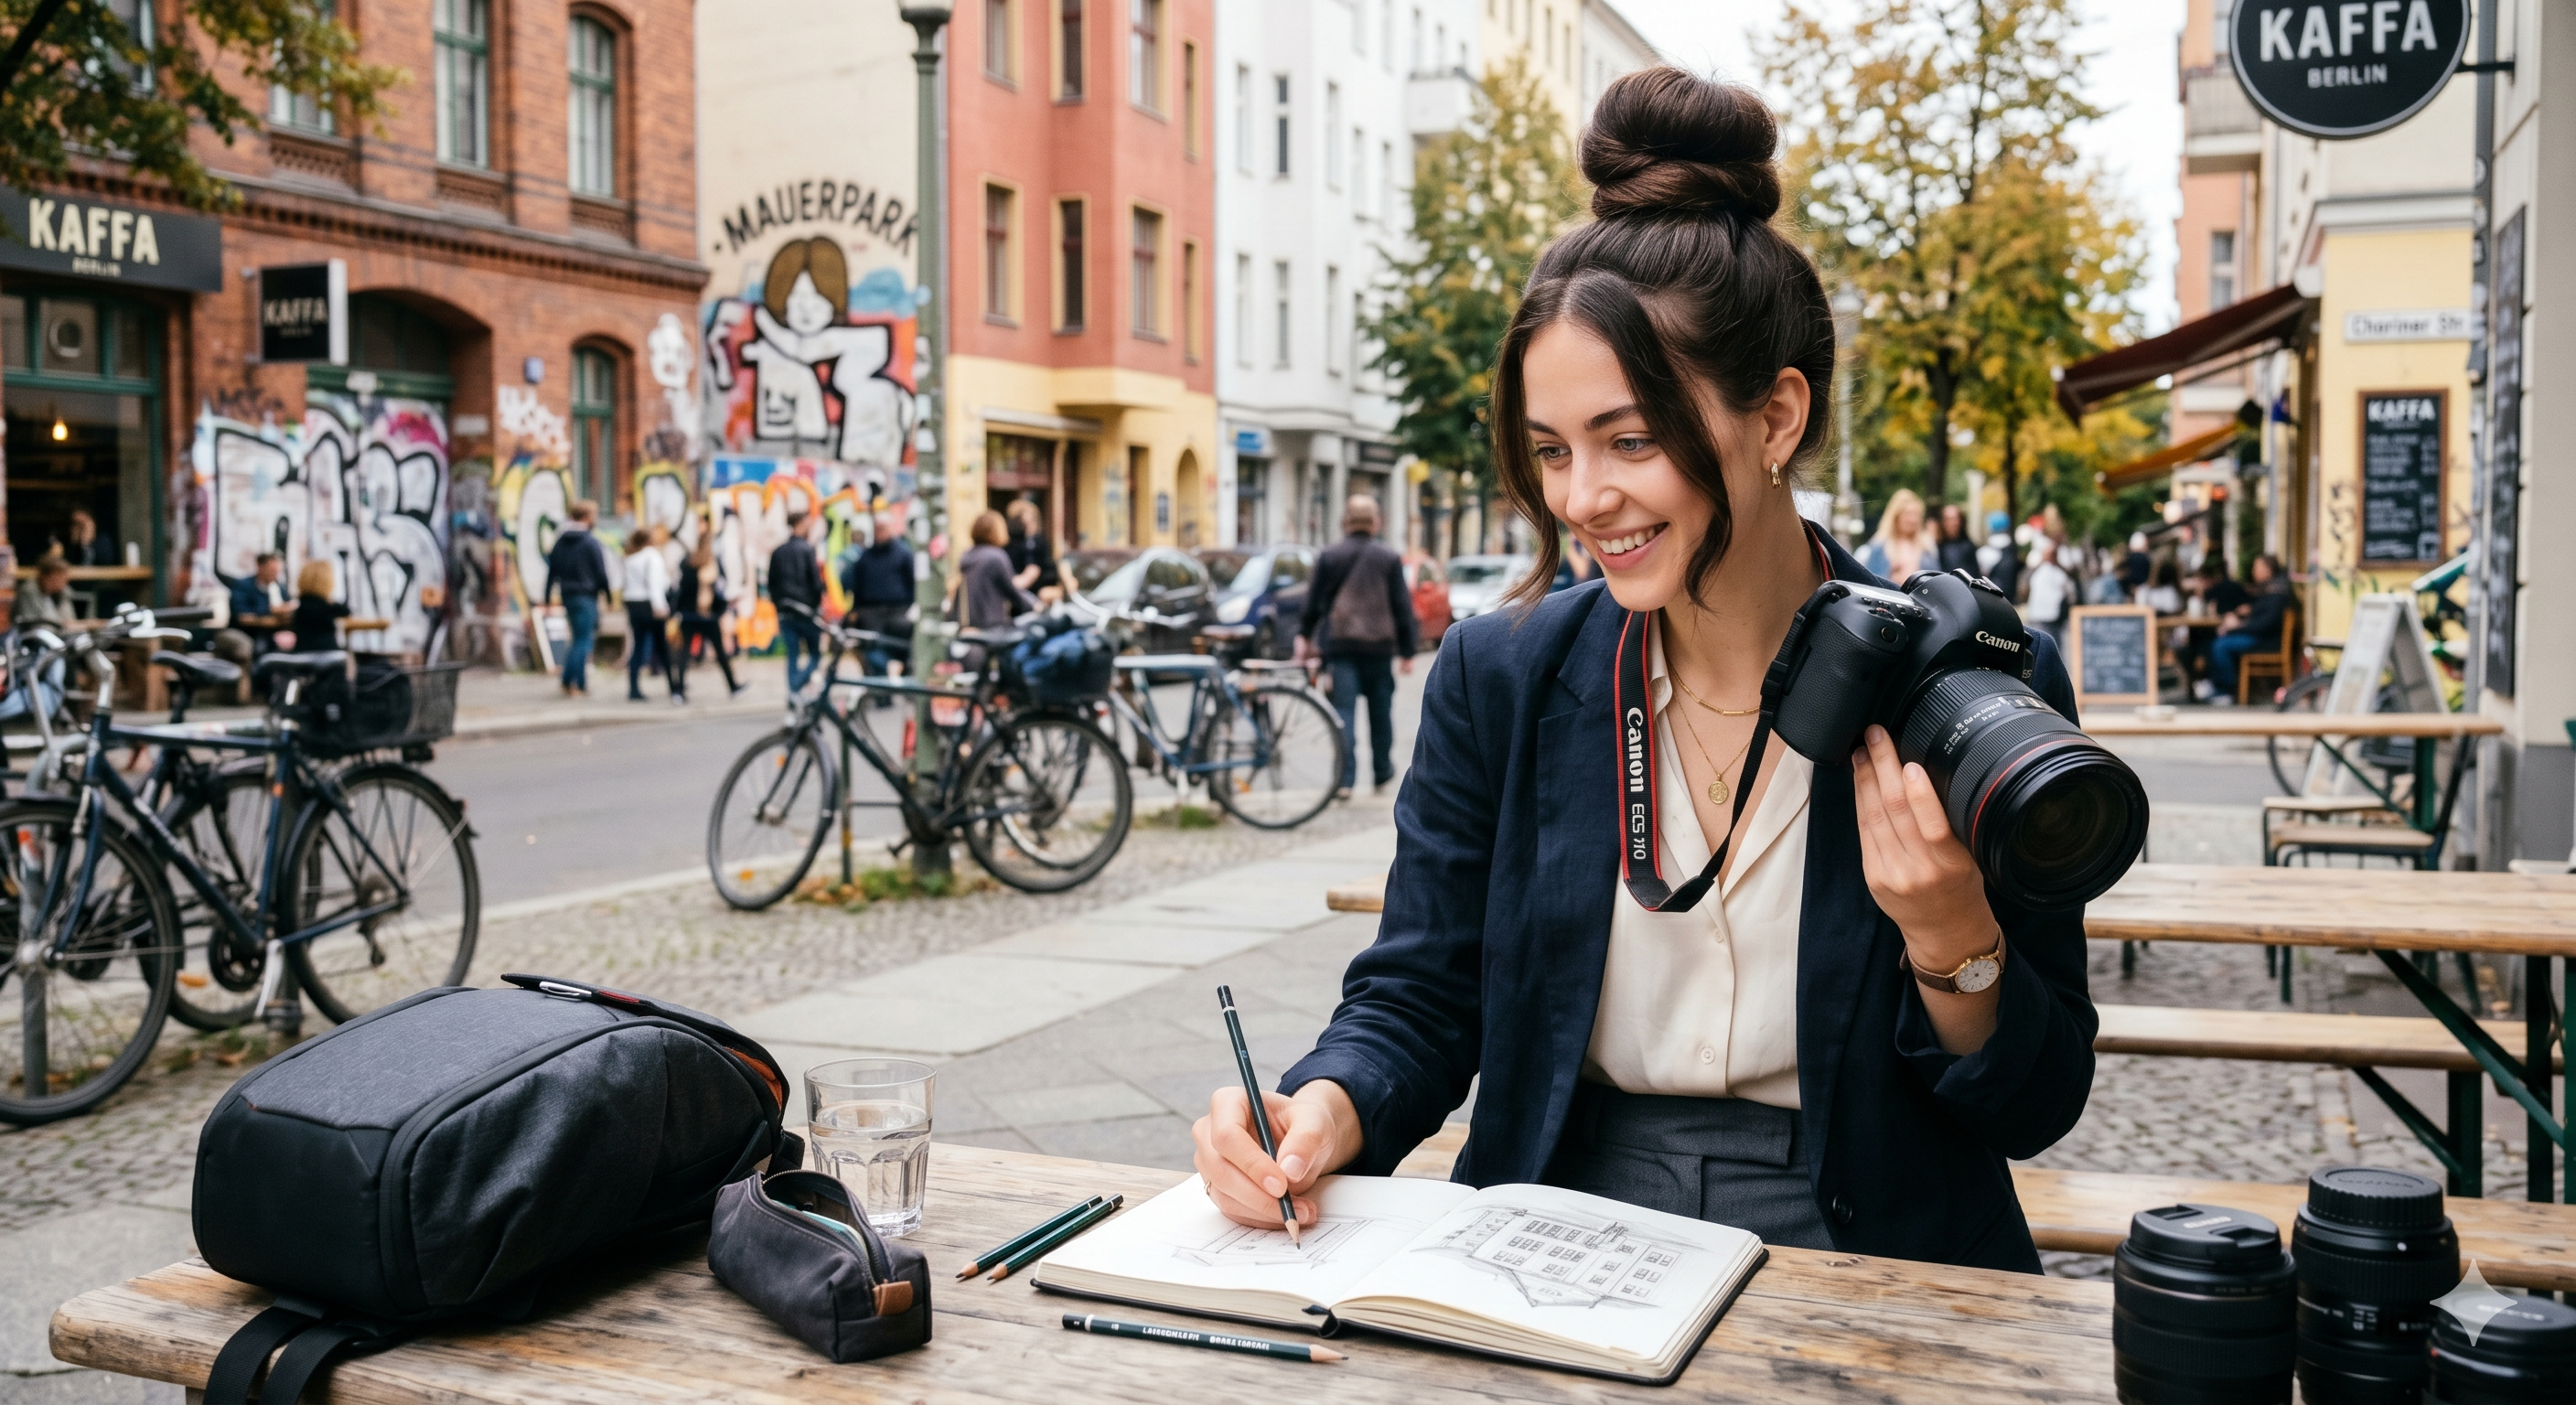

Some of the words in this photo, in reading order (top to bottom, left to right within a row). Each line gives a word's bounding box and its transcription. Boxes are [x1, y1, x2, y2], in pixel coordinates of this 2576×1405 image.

[2259, 0, 2438, 62] KAFFA
[2307, 63, 2388, 89] BERLIN
[28, 197, 160, 265] KAFFA
[263, 297, 328, 326] KAFFA
[2367, 398, 2436, 422] KAFFA
[1975, 630, 2021, 653] Canon
[1626, 707, 1644, 792] Canon
